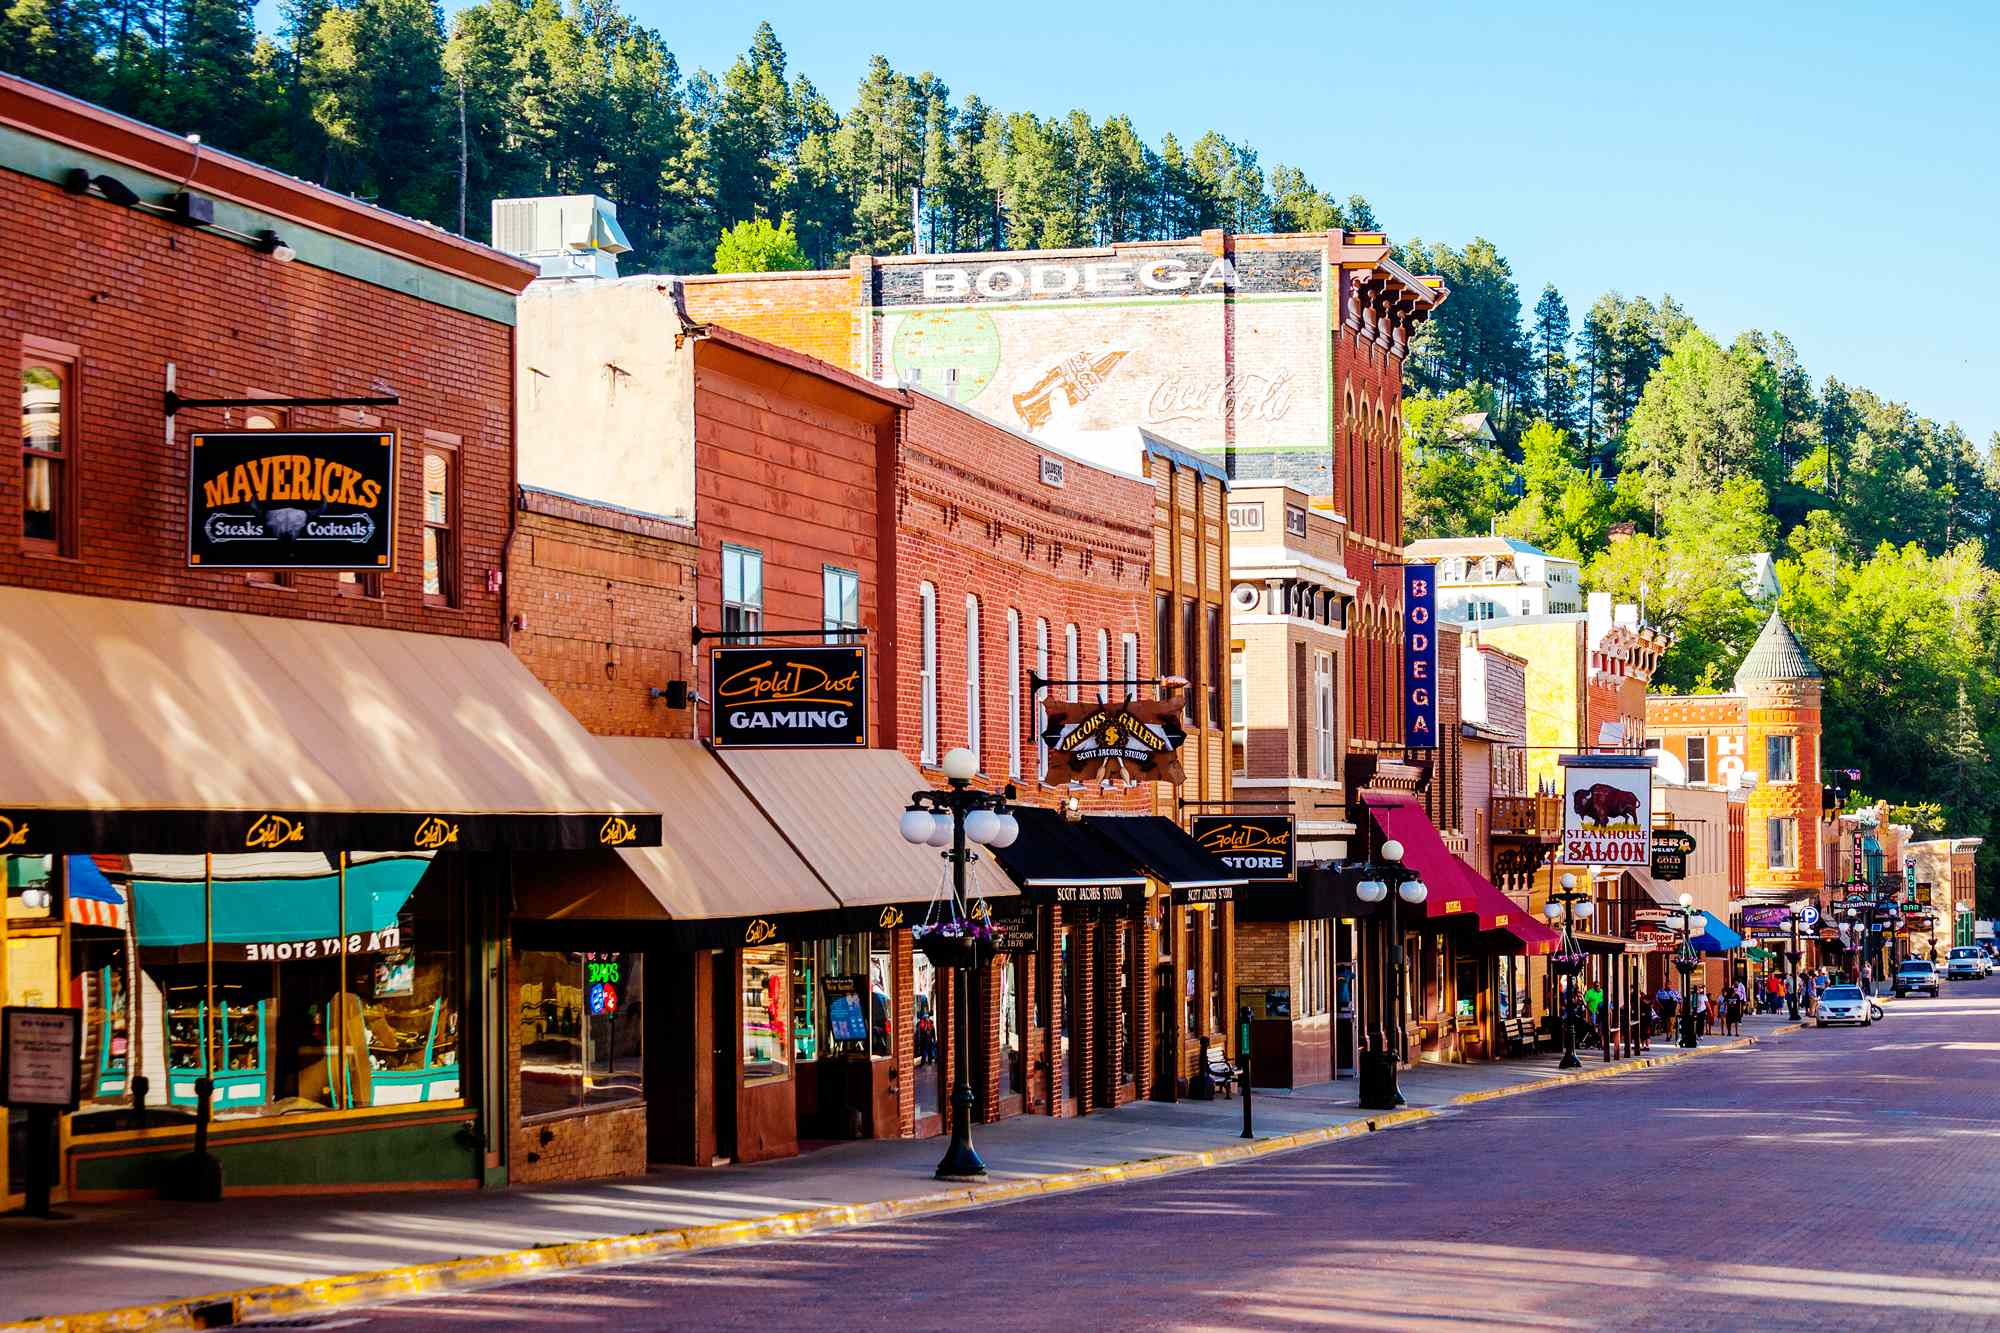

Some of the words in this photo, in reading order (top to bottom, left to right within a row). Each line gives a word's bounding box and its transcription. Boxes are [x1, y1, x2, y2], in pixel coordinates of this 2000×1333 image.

[922, 257, 1243, 298] BODEGA
[203, 454, 382, 509] MAVERICKS
[214, 521, 264, 536] Steaks
[306, 521, 368, 536] Cocktails
[1411, 579, 1429, 733] BODEGA
[718, 660, 792, 697] Gold
[771, 661, 860, 698] Dust
[729, 710, 849, 729] GAMING
[1062, 711, 1106, 751] JACOBS
[1118, 712, 1165, 751] GALLERY
[1076, 749, 1097, 761] SCOTT
[1098, 748, 1123, 757] JACOBS
[1124, 749, 1148, 761] STUDIO
[1197, 823, 1244, 848] Gold
[1231, 825, 1290, 849] Dust
[1566, 829, 1648, 840] STEAKHOUSE
[1567, 840, 1646, 862] SALOON
[1221, 856, 1284, 869] STORE
[1057, 888, 1077, 901] SCOTT
[1079, 887, 1100, 901] JACOBS
[1102, 887, 1123, 901] STUDIO
[1637, 933, 1649, 941] Big
[1649, 933, 1673, 943] Dipper
